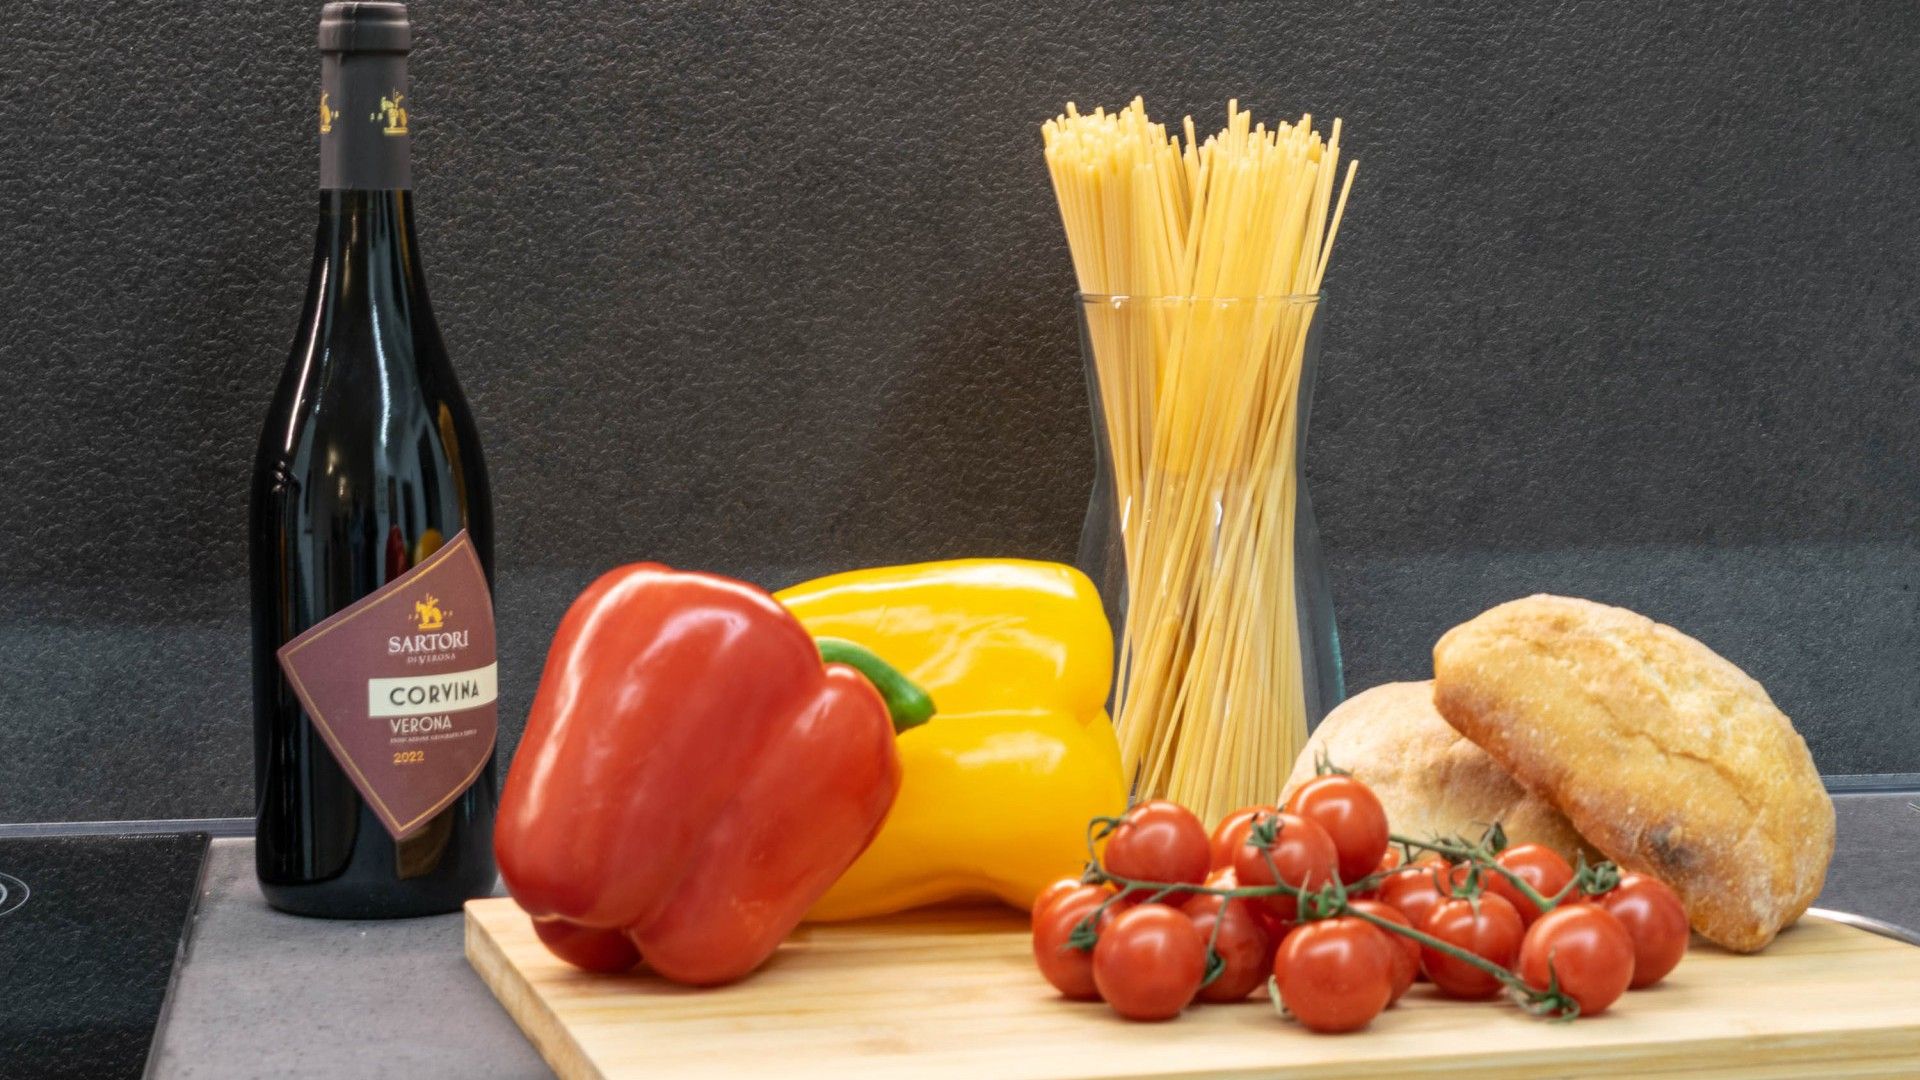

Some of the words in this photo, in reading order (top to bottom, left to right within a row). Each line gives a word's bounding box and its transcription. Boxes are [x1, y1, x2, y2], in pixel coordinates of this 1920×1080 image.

[388, 630, 469, 653] SARTORI
[407, 656, 417, 664] DI
[418, 652, 456, 664] VERONA
[390, 679, 480, 706] CORVINA
[390, 715, 452, 734] VERONA
[393, 751, 425, 764] 2022
